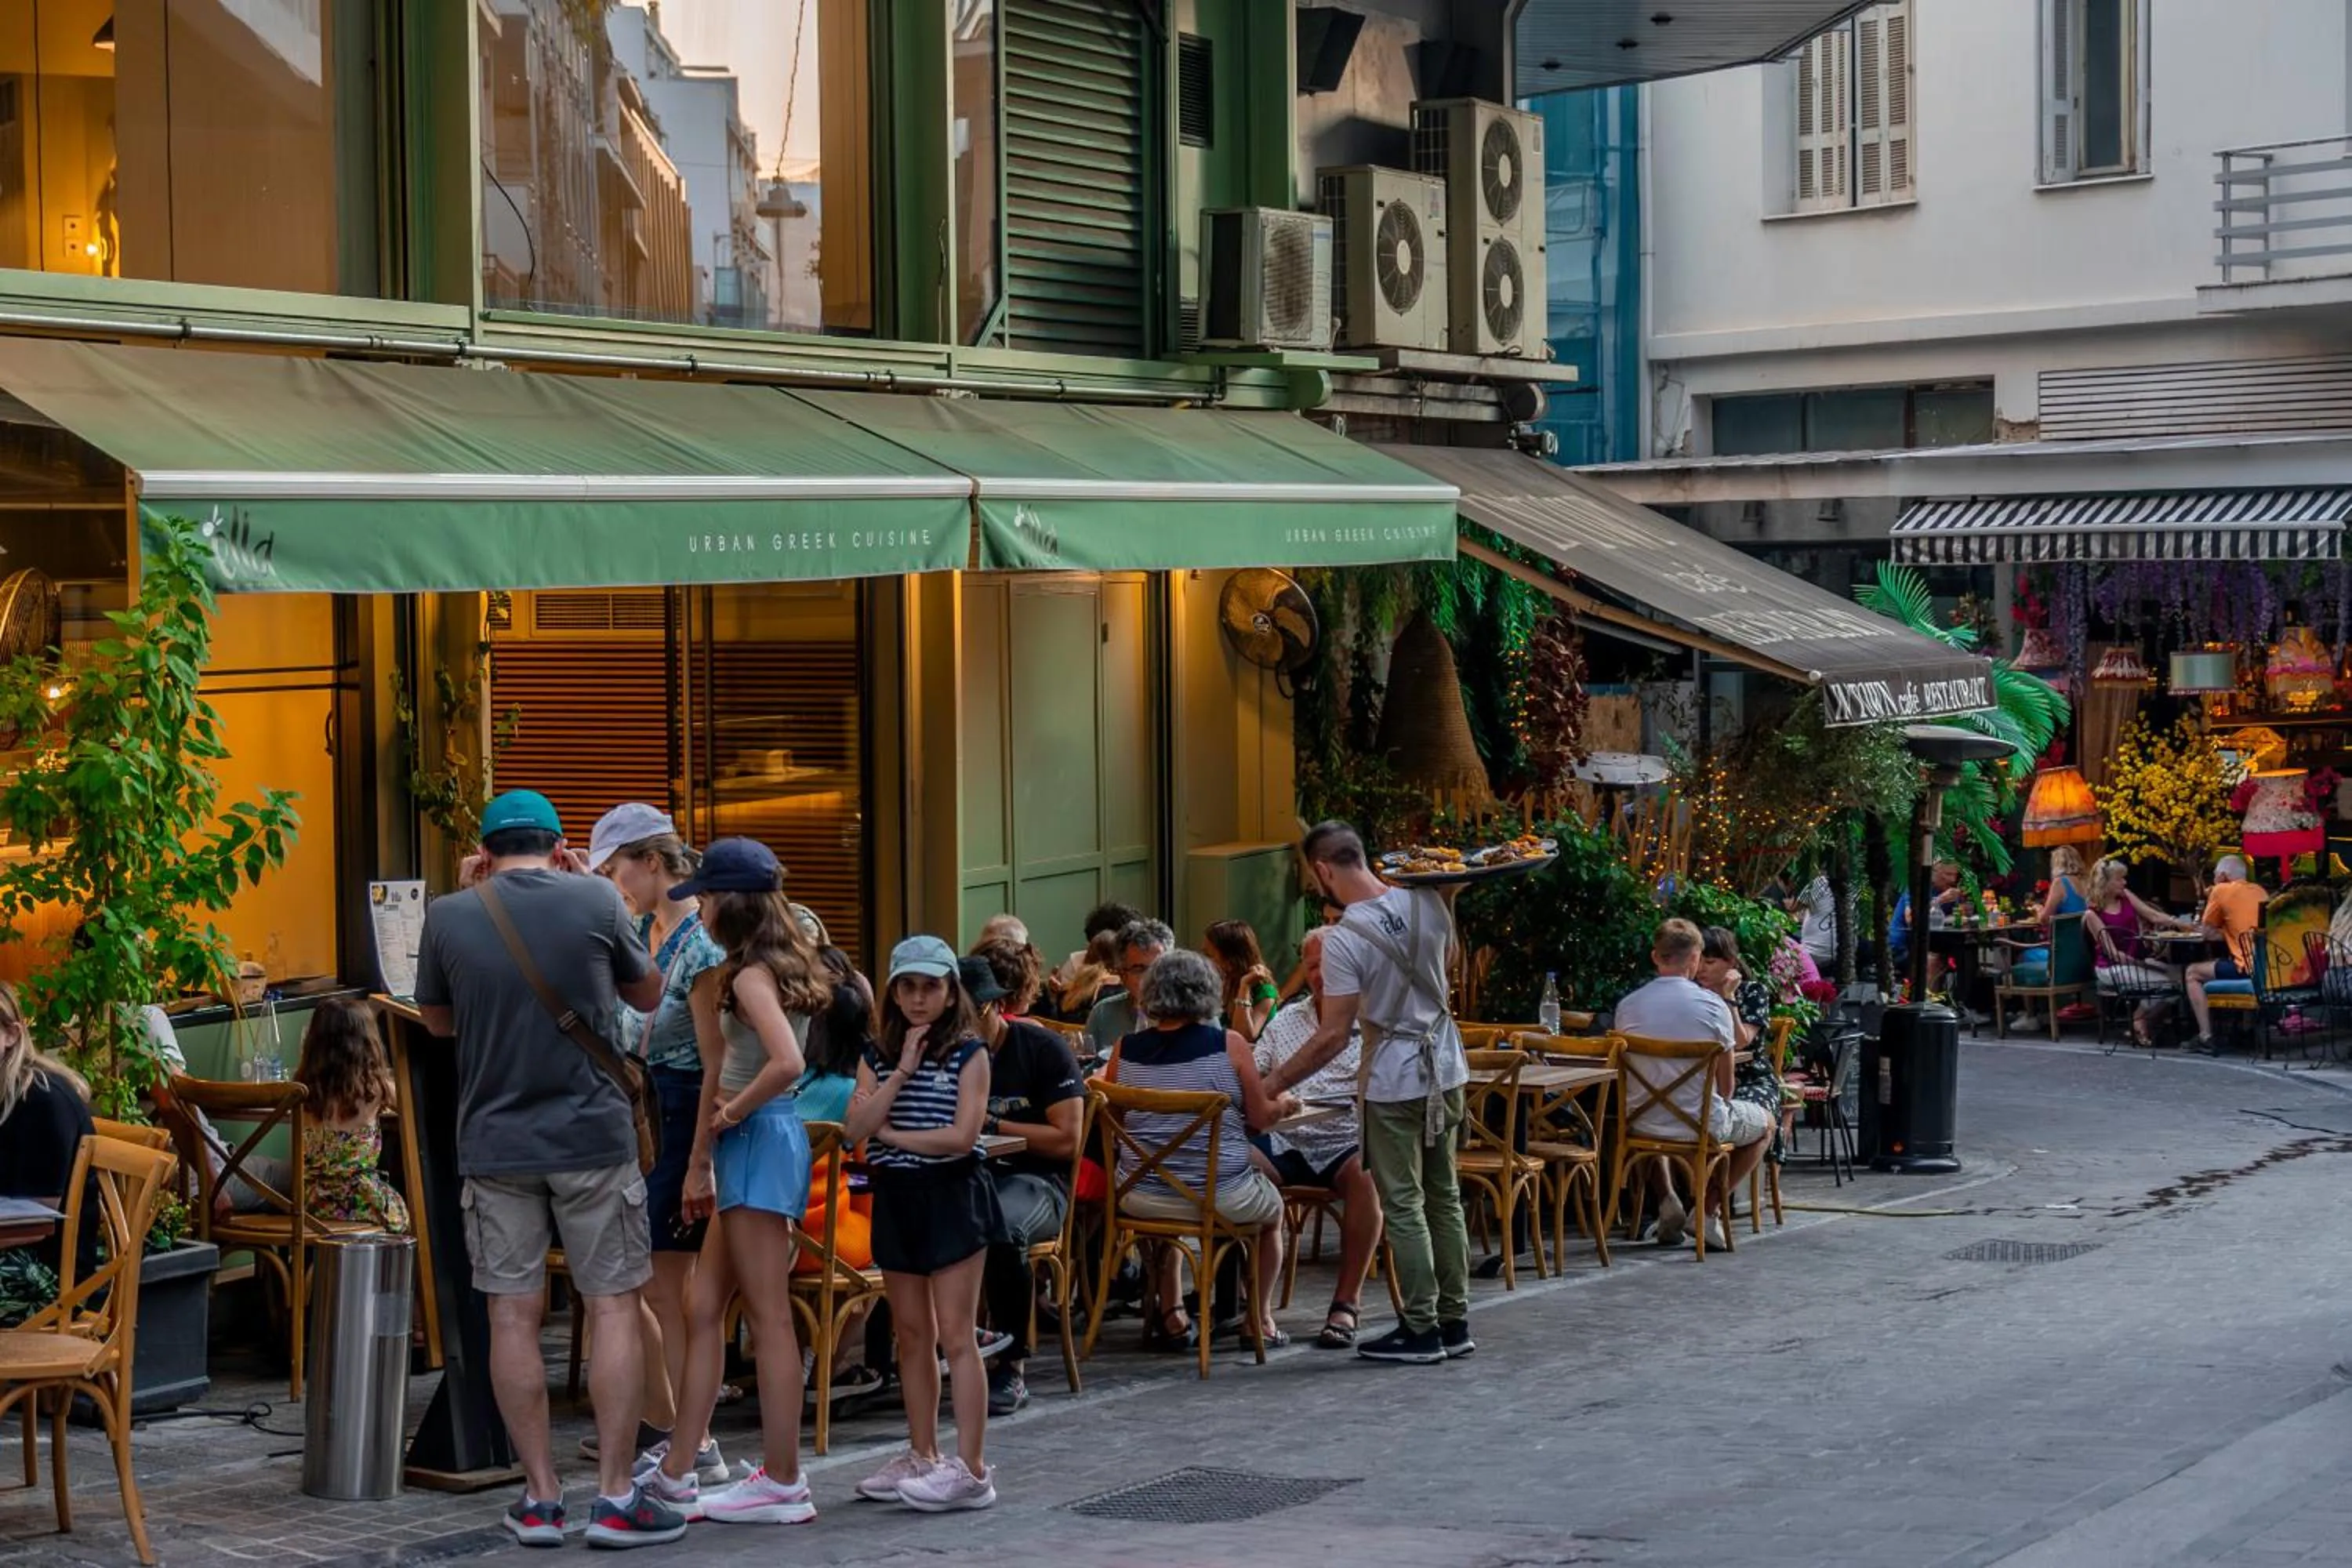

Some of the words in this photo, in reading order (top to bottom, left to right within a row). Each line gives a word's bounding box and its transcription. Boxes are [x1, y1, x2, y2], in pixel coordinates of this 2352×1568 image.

[689, 535, 755, 553] URBAN
[771, 532, 837, 551] GREEK
[852, 528, 931, 548] CUISINE
